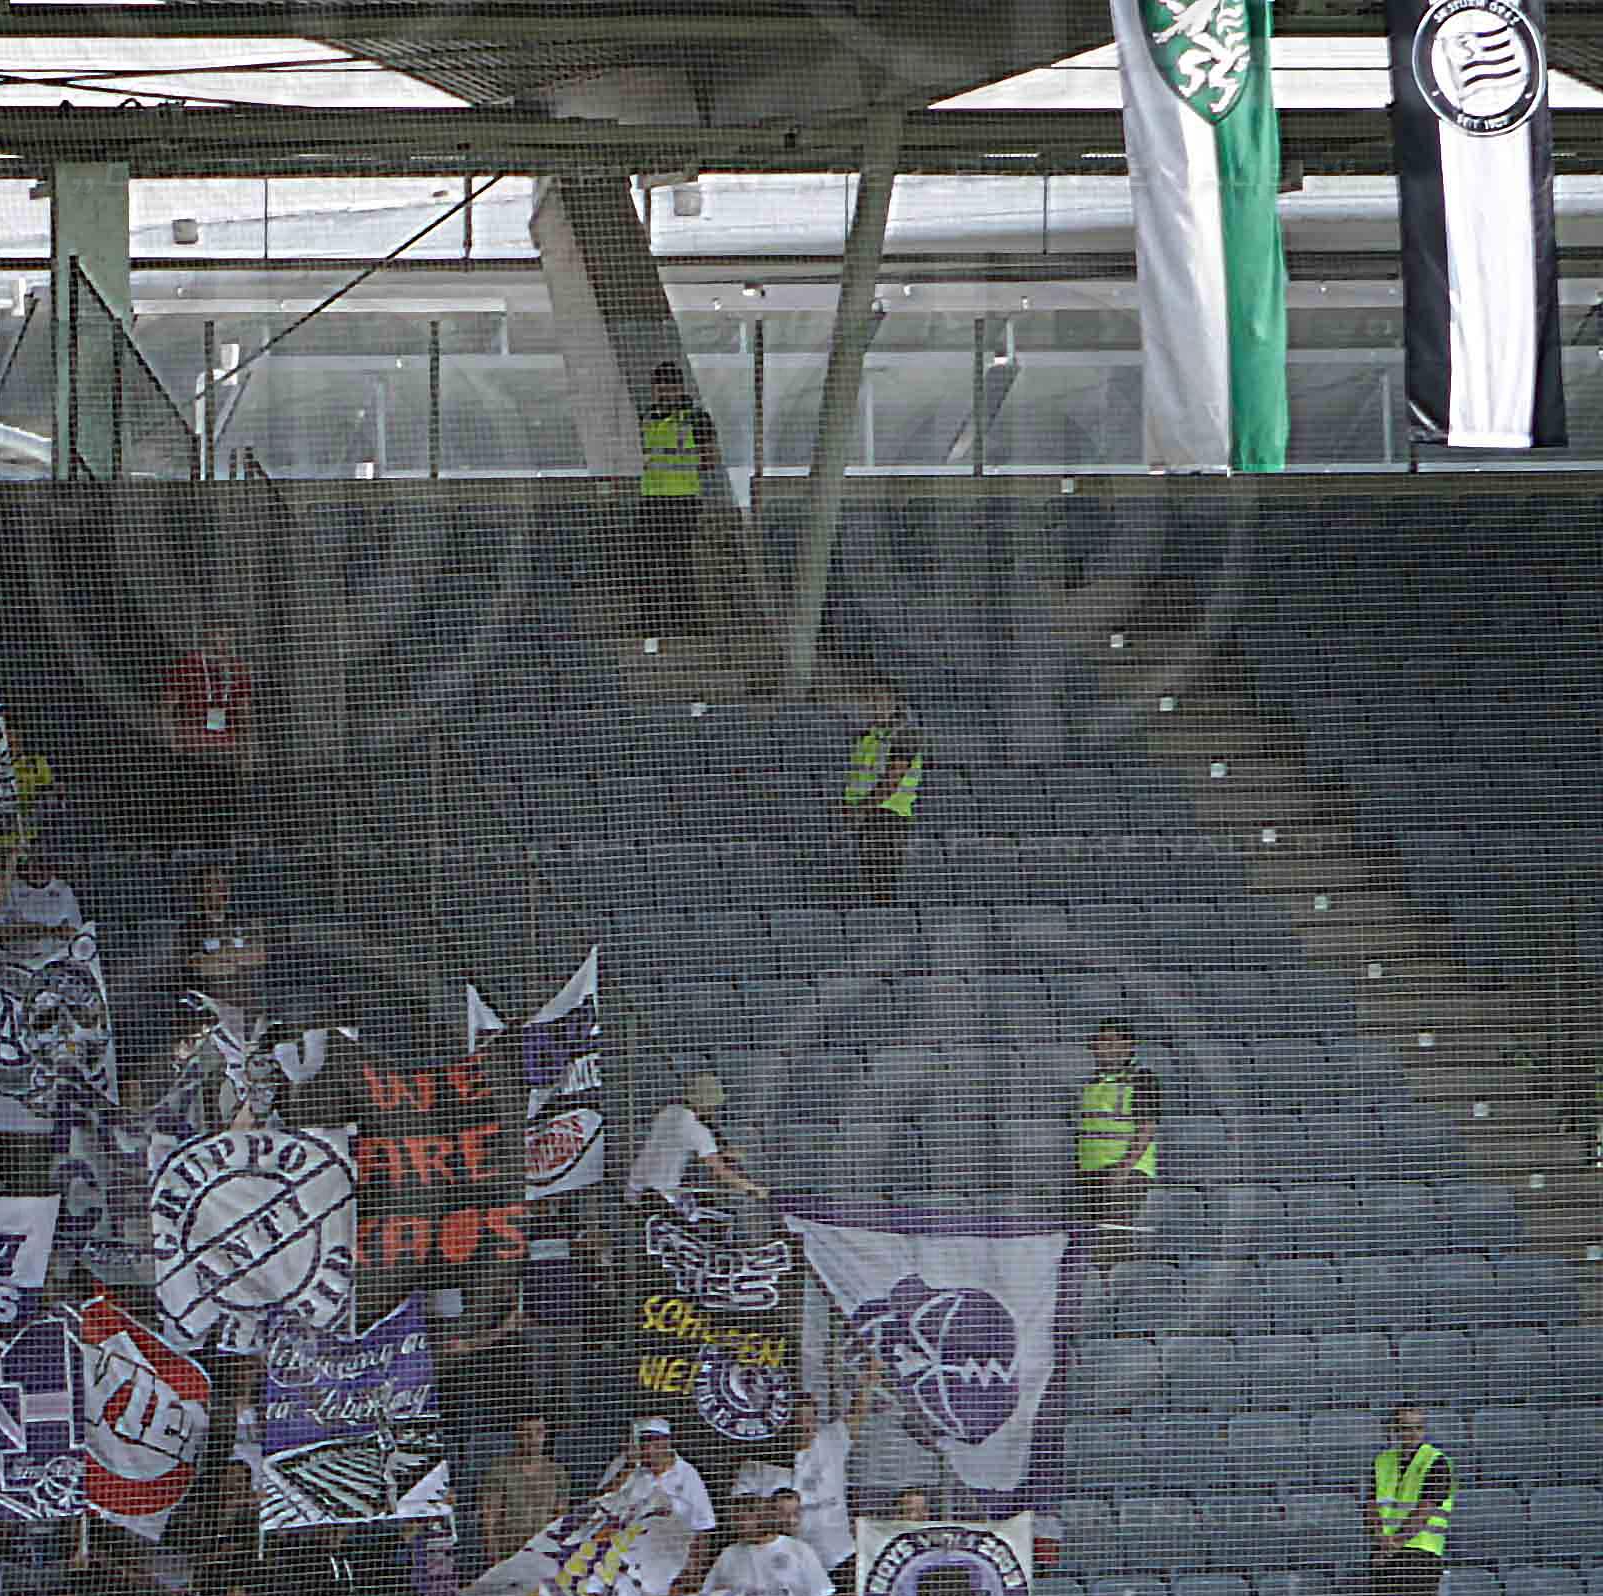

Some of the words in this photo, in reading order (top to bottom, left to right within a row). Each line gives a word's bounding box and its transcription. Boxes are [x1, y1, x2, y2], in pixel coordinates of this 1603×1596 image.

[362, 1053, 493, 1114] WE
[357, 1123, 501, 1186] ARE
[194, 1194, 309, 1294] ANTI
